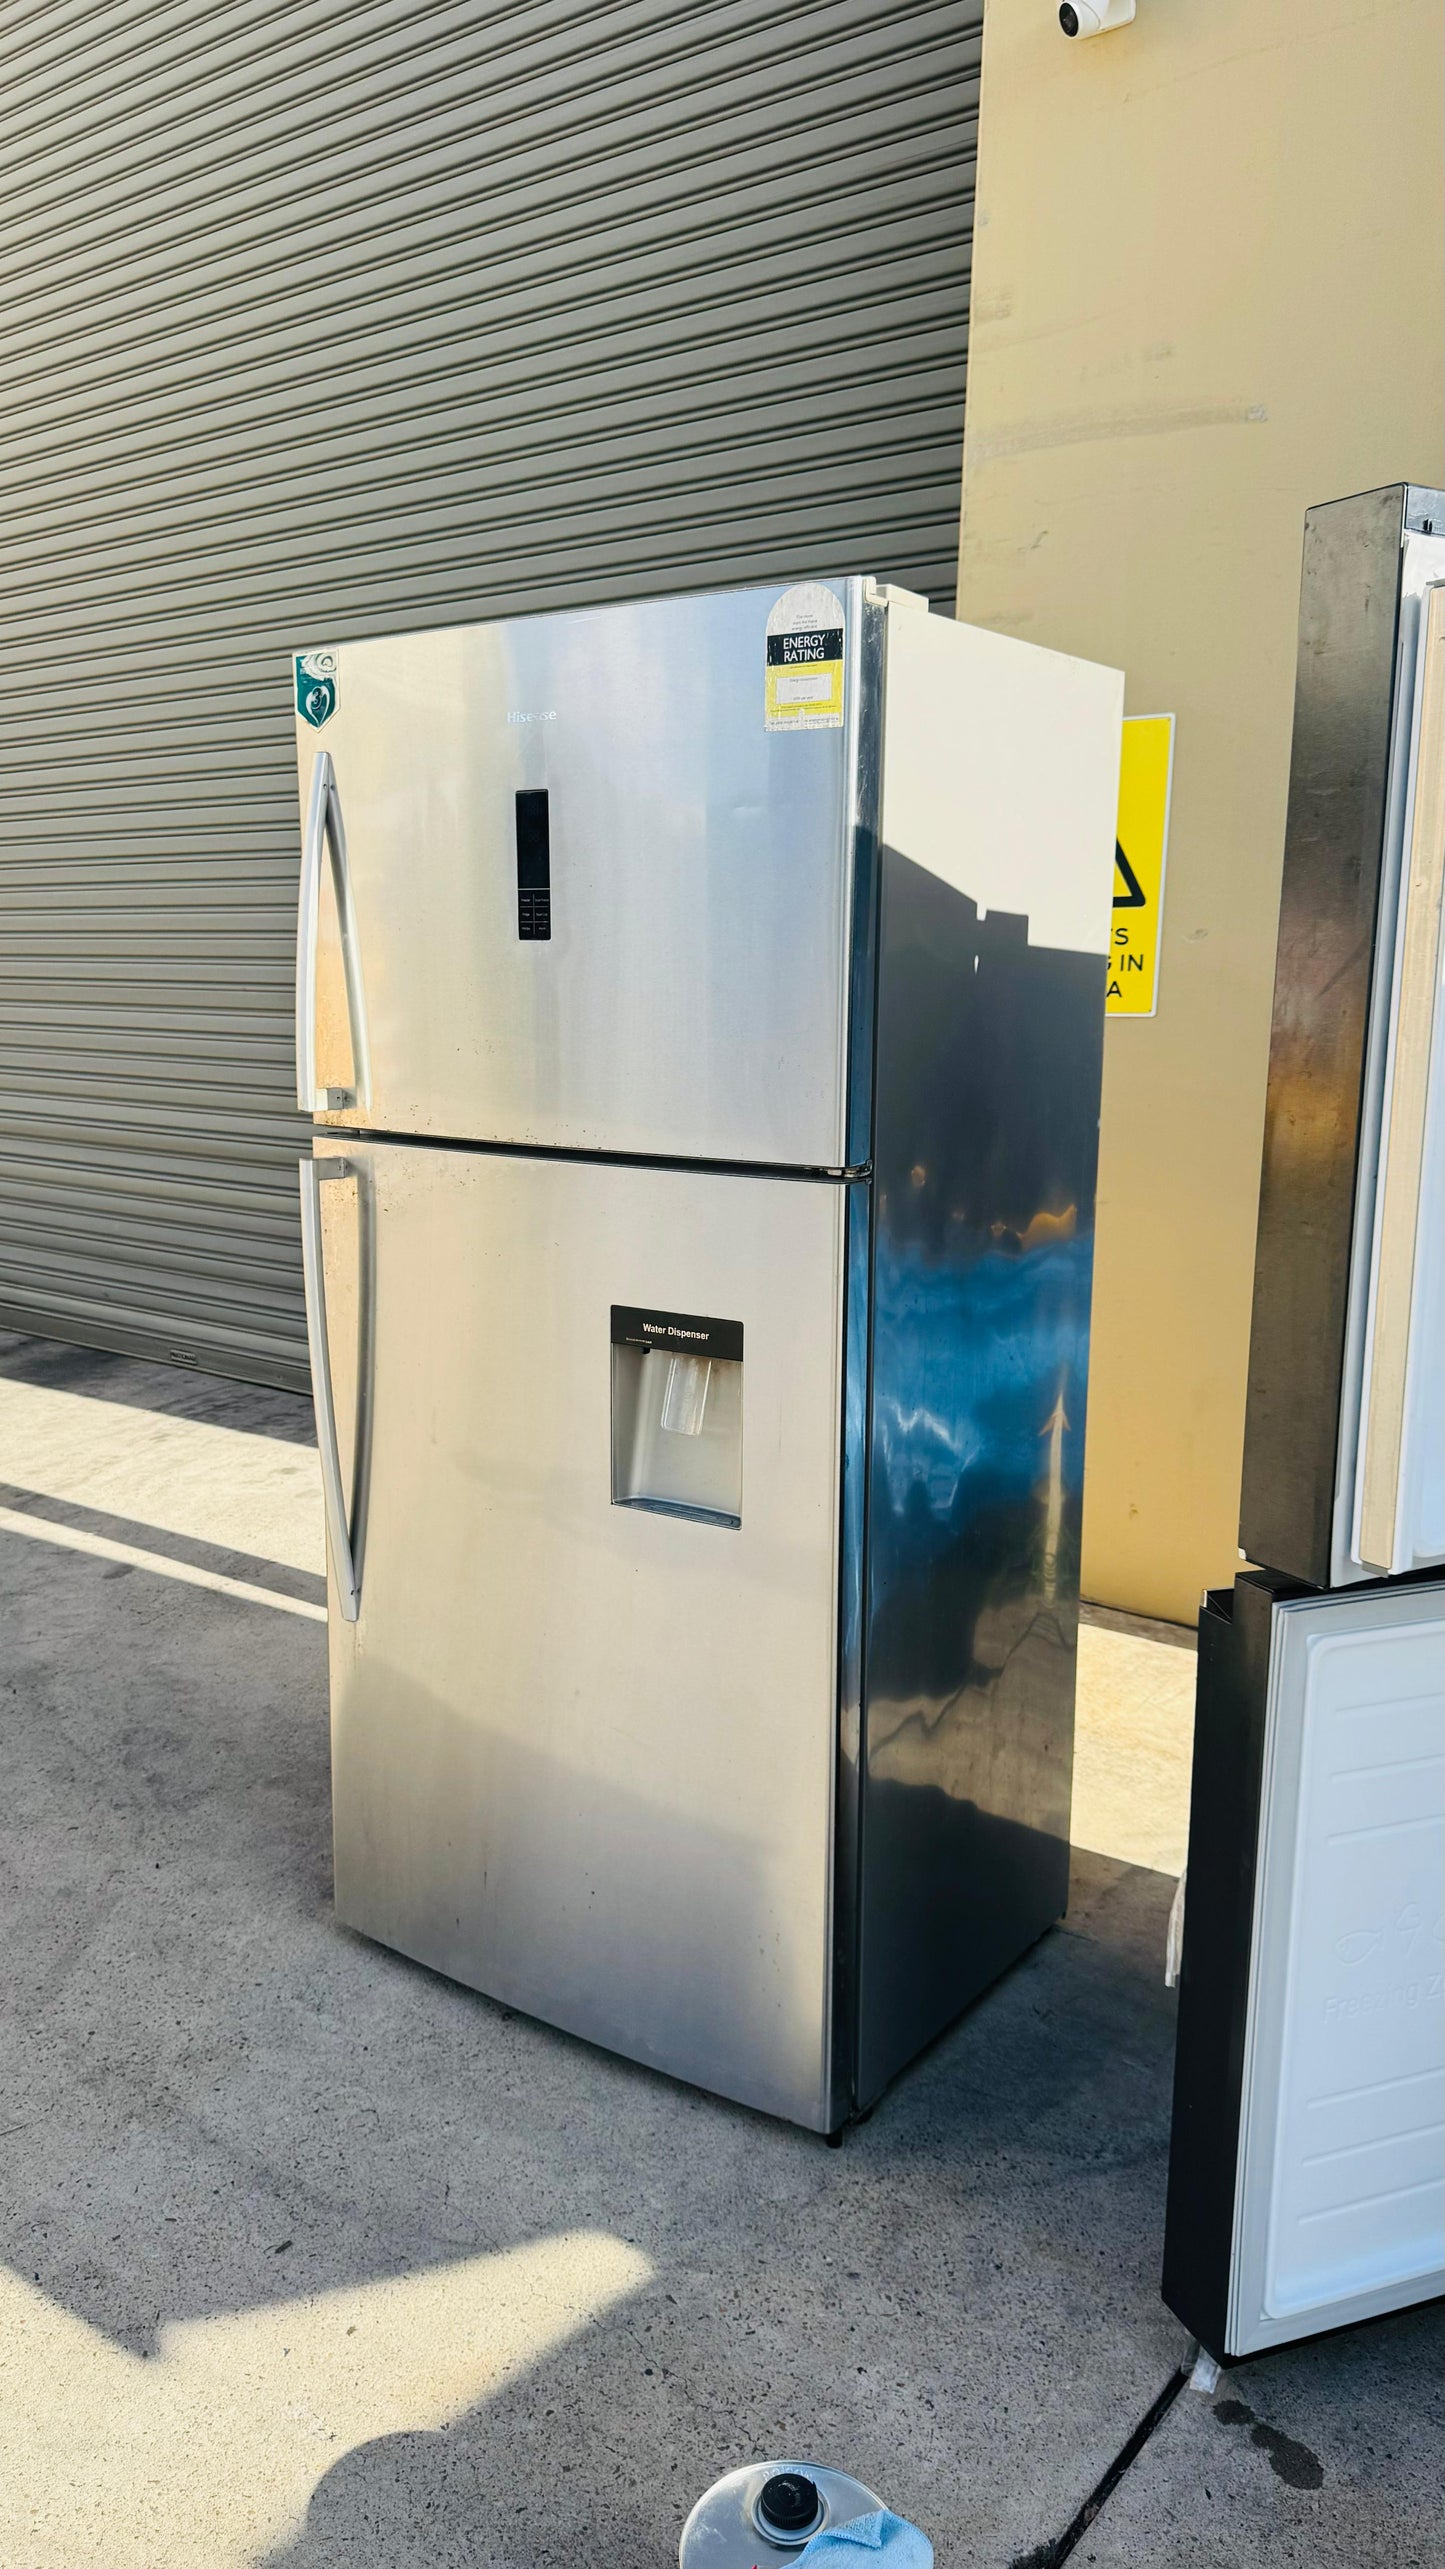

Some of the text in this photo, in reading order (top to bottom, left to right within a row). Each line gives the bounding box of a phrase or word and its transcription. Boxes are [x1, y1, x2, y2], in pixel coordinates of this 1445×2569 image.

[784, 635, 825, 649] ENERGY
[784, 648, 824, 662] RATING
[1111, 928, 1128, 945] S
[1121, 954, 1143, 971] IN
[643, 1323, 709, 1340] Water Dispenser
